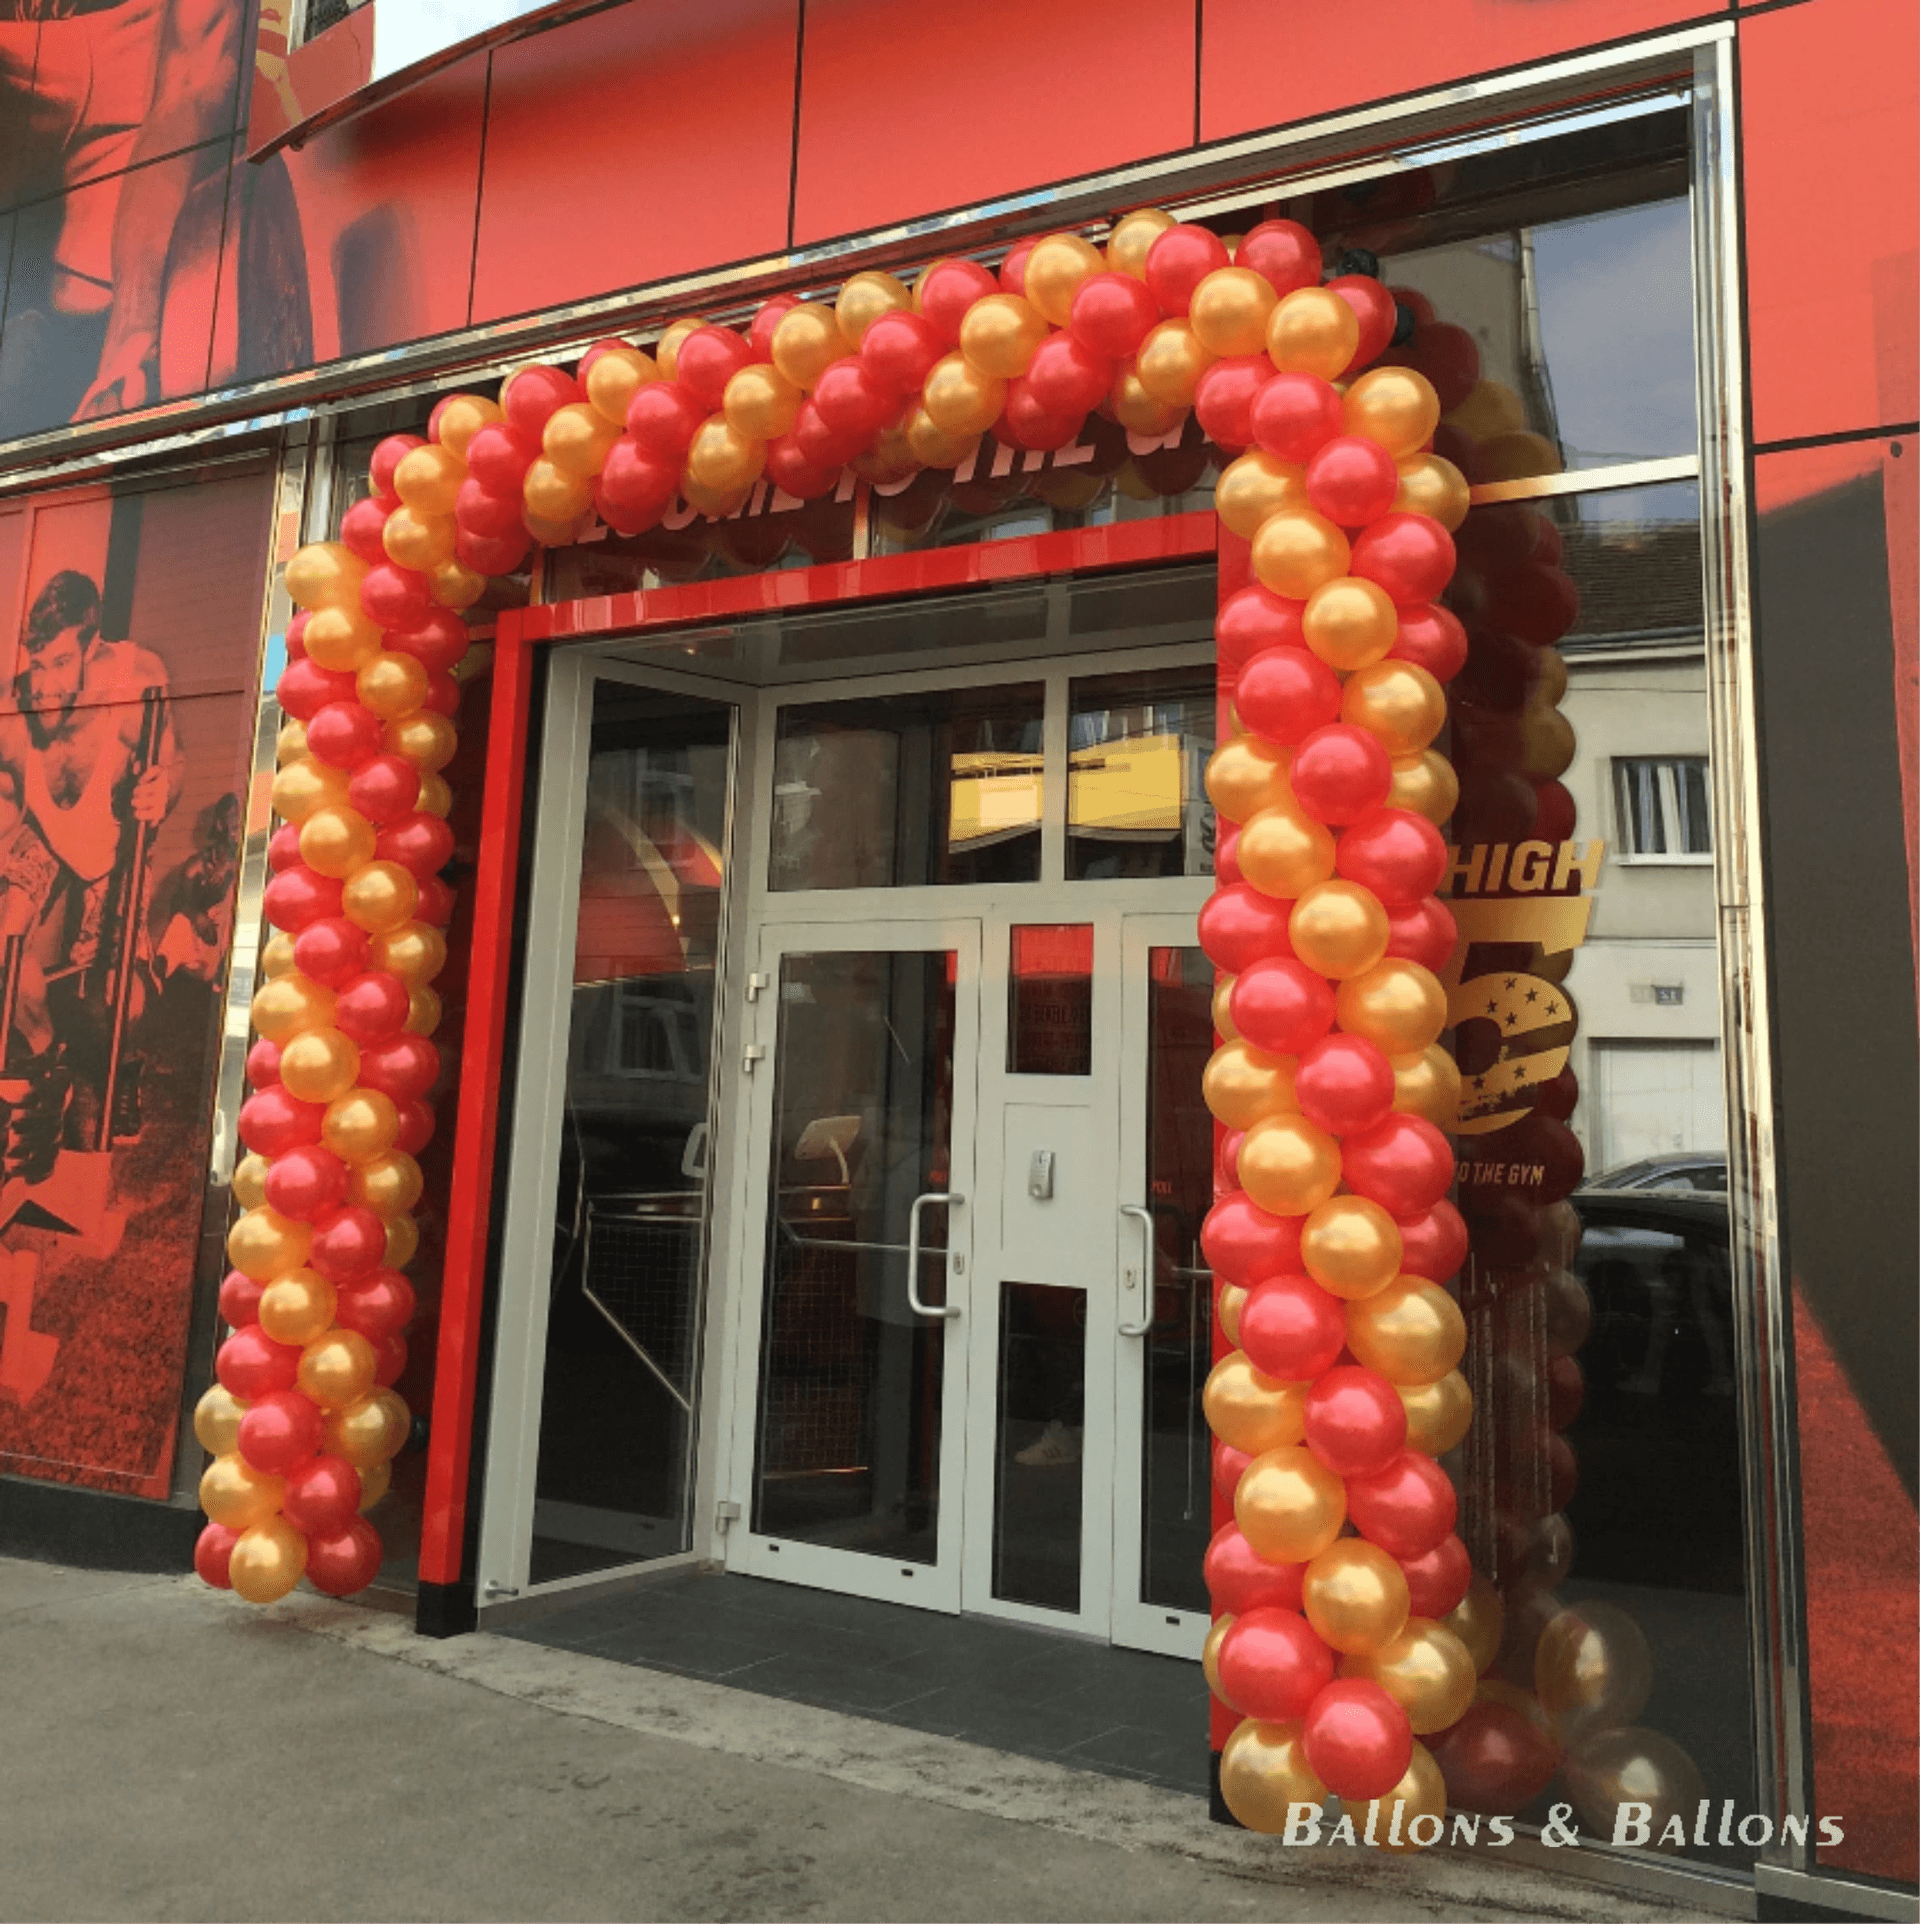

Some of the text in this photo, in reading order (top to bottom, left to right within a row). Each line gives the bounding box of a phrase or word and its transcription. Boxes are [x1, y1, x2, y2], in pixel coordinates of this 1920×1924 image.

[1438, 838, 1605, 893] HIGH
[1455, 1161, 1545, 1186] O THE GYM
